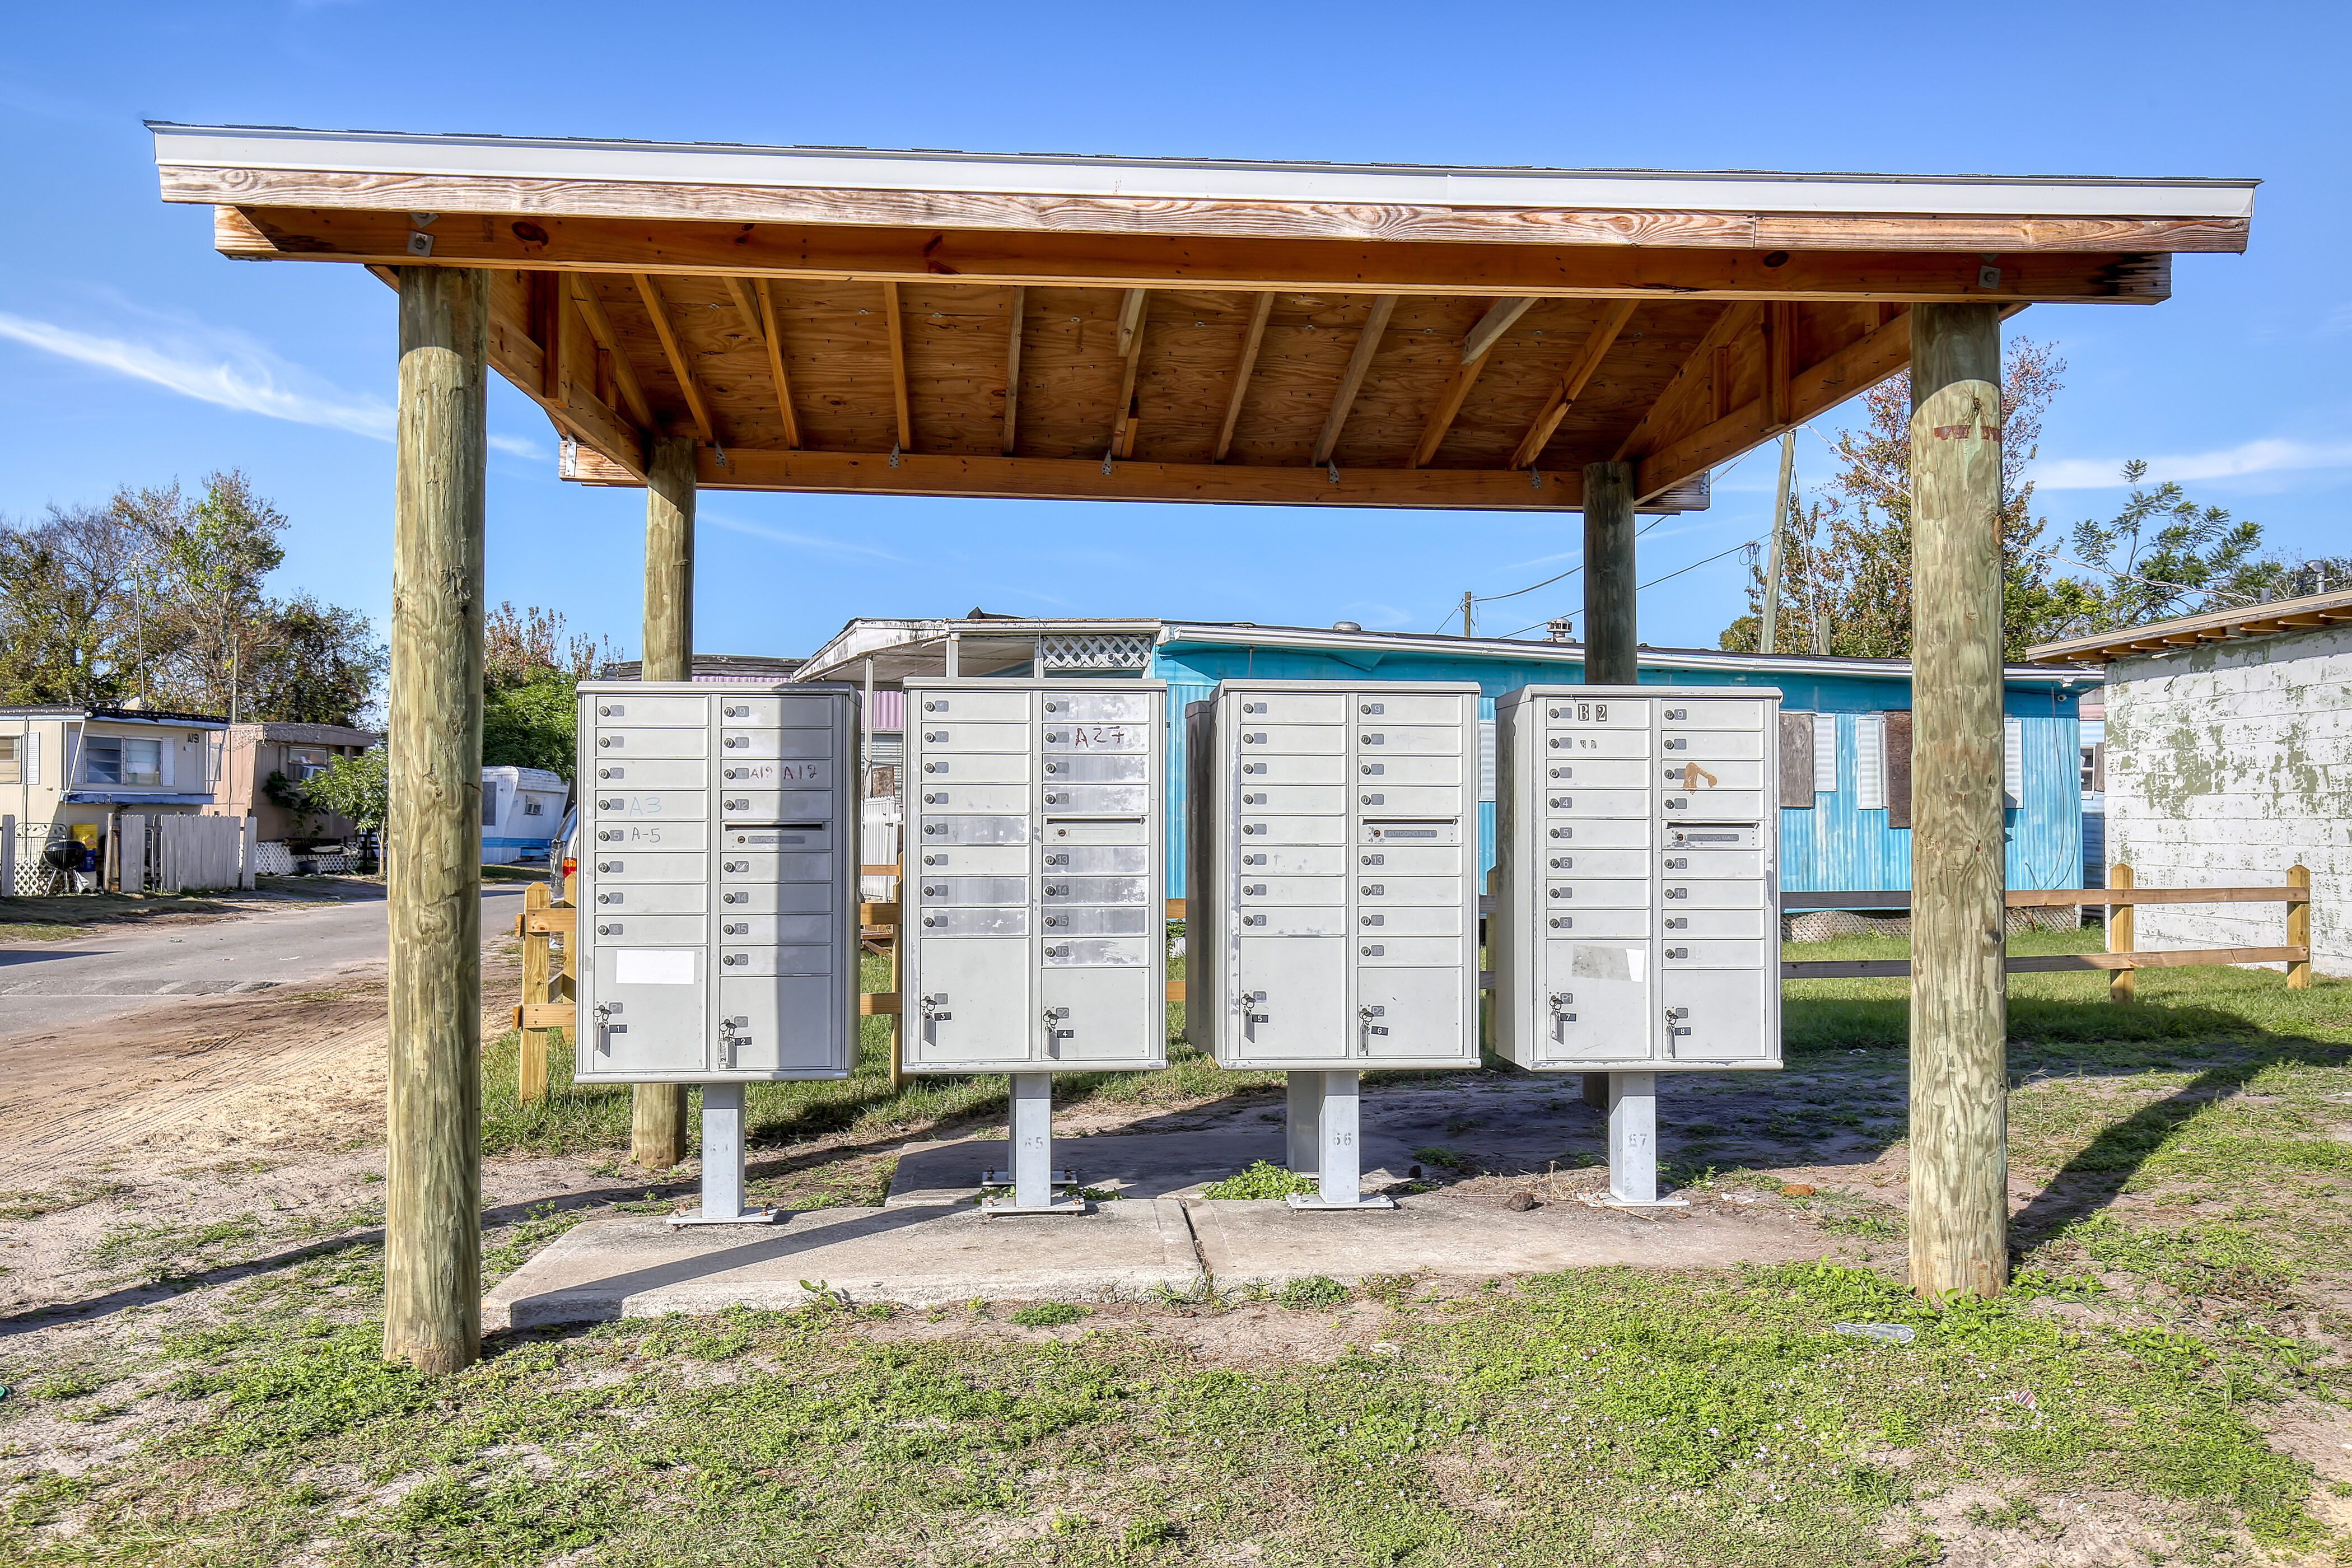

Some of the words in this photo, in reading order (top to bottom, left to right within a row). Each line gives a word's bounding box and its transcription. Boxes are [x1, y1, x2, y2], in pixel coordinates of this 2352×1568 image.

[739, 707, 745, 716] 9
[1375, 704, 1380, 713] 9
[1677, 711, 1683, 719] 9
[738, 738, 747, 748] 10
[1058, 795, 1068, 804] 12
[1562, 799, 1568, 807] 4
[738, 800, 748, 809] 12
[939, 825, 945, 834] 5
[1563, 829, 1569, 837] 5
[613, 831, 620, 840] 5
[631, 827, 661, 843] A-5
[1058, 856, 1068, 864] 13
[1373, 856, 1383, 864] 13
[1563, 858, 1569, 867] 6
[1676, 859, 1686, 867] 13
[1057, 885, 1067, 894] 14
[1257, 885, 1263, 894] 7
[1373, 885, 1383, 894] 14
[1676, 889, 1686, 897] 14
[613, 893, 620, 903] 7
[737, 893, 747, 902] 14
[1058, 917, 1068, 925] 15
[1257, 916, 1263, 924] 8
[1563, 918, 1569, 927] 8
[1677, 919, 1686, 928] 15
[613, 925, 619, 934] 8
[737, 924, 746, 934] 15
[1058, 947, 1067, 956] 16
[1677, 949, 1687, 958] 16
[738, 955, 747, 964] 16
[1256, 992, 1266, 1001] P1
[1562, 994, 1572, 1003] P1
[612, 1004, 622, 1012] P1
[1373, 1007, 1384, 1016] P2
[1057, 1009, 1068, 1018] P2
